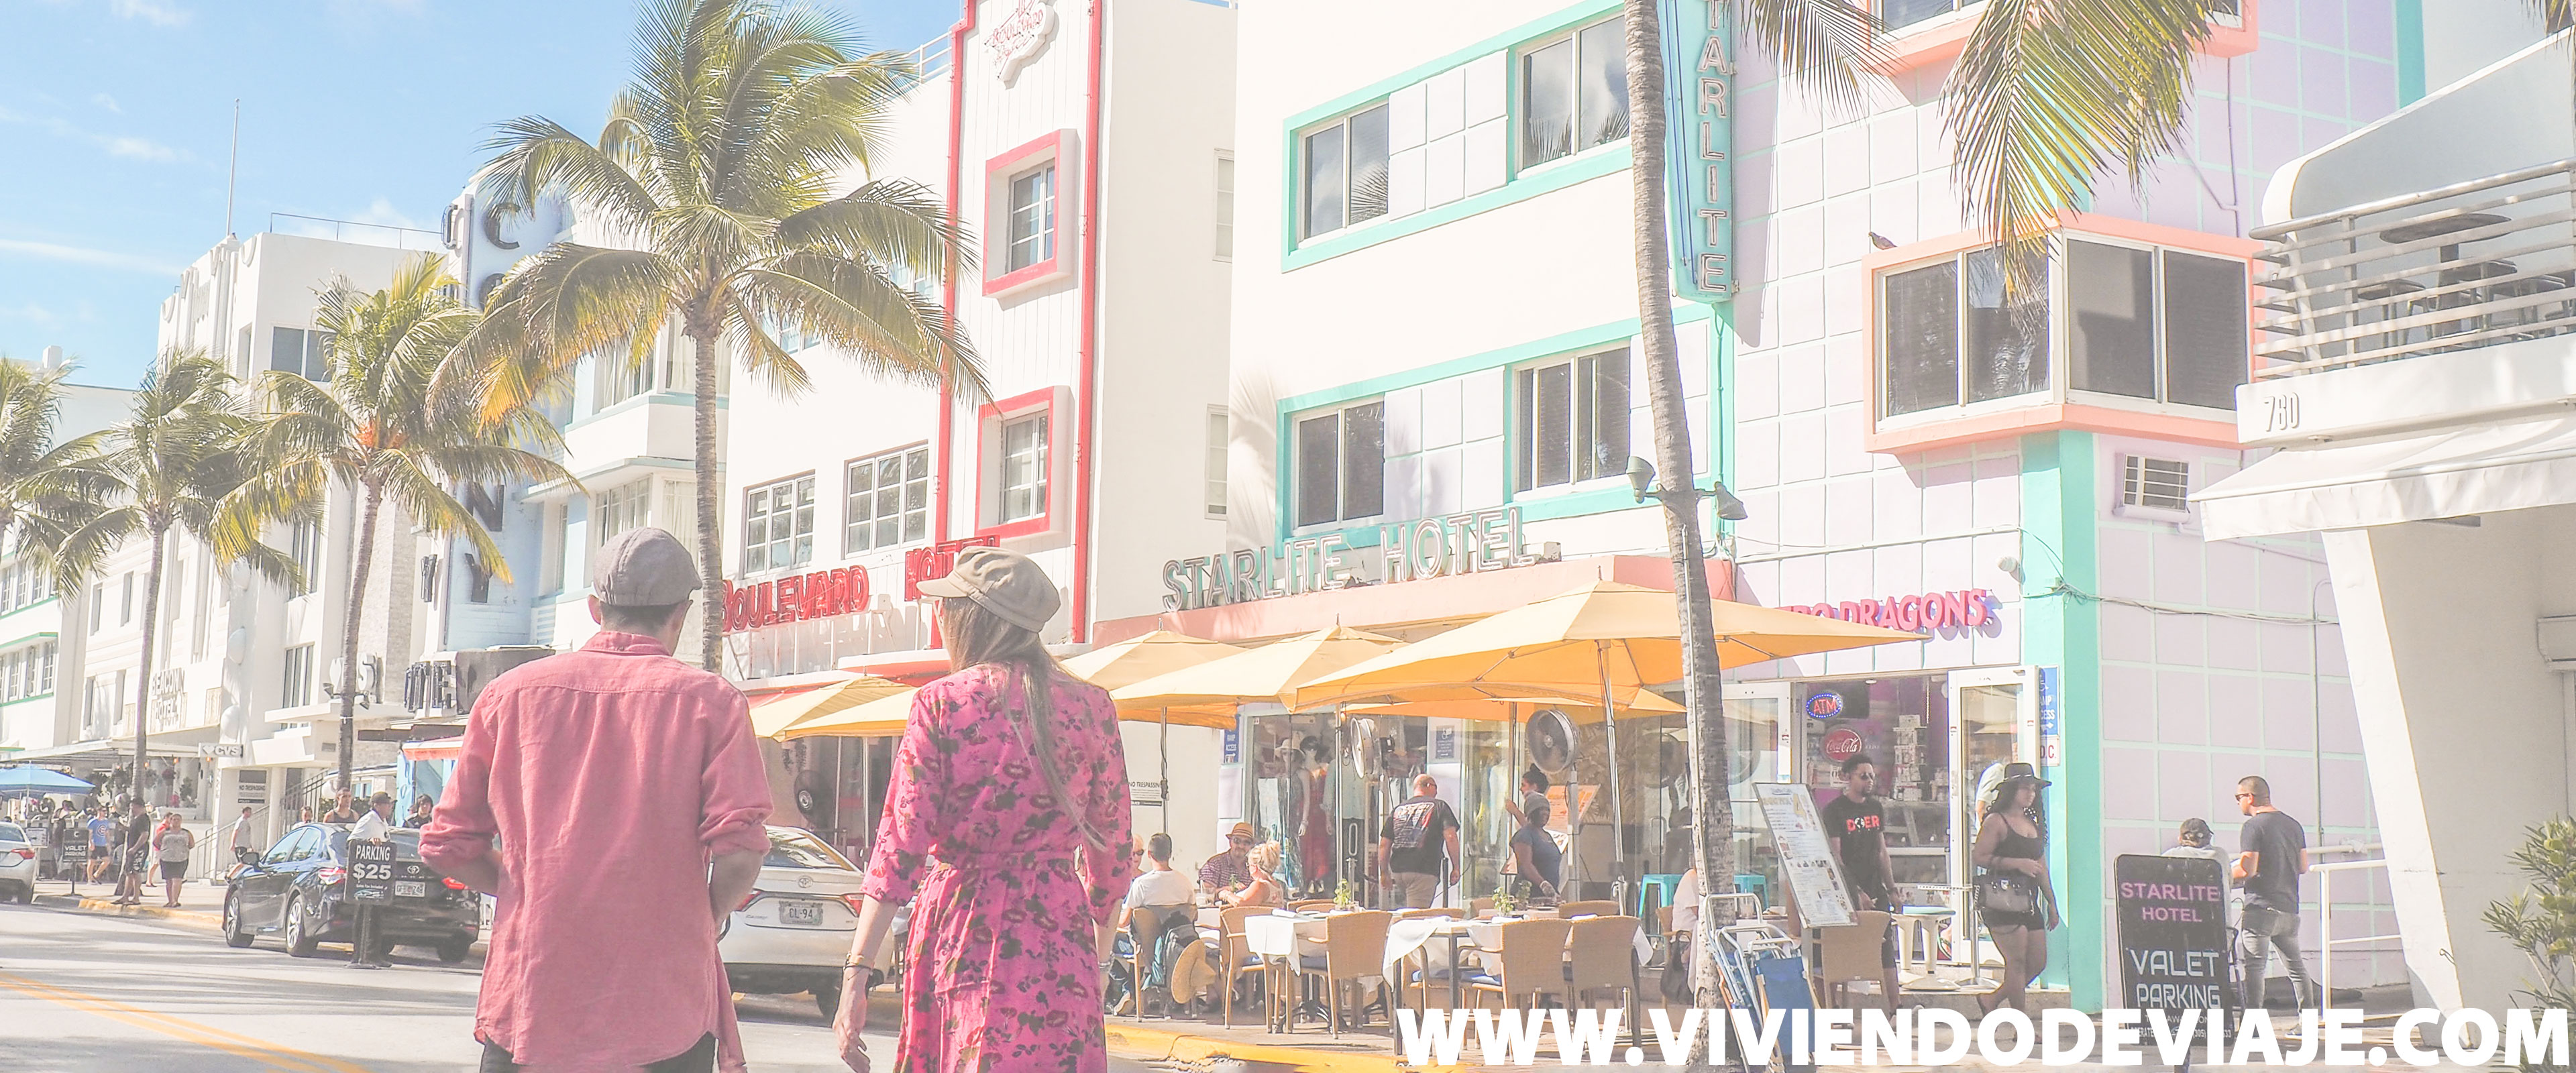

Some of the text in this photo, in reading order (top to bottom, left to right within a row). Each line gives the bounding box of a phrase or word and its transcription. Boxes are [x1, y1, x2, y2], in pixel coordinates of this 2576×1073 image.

[1162, 507, 1536, 612] STARLITE HOTEL
[722, 565, 869, 632] BOULEVARD
[1839, 588, 1988, 631] DRAGONS
[152, 667, 184, 696] BEACON
[1813, 697, 1837, 714] ATM
[215, 744, 239, 756] CVS
[356, 845, 391, 861] PARKING
[352, 862, 392, 881] $25
[2121, 882, 2220, 902] STARLITE
[2143, 907, 2203, 923] HOTEL
[2129, 950, 2220, 977] VALET
[2136, 983, 2222, 1009] PARKING
